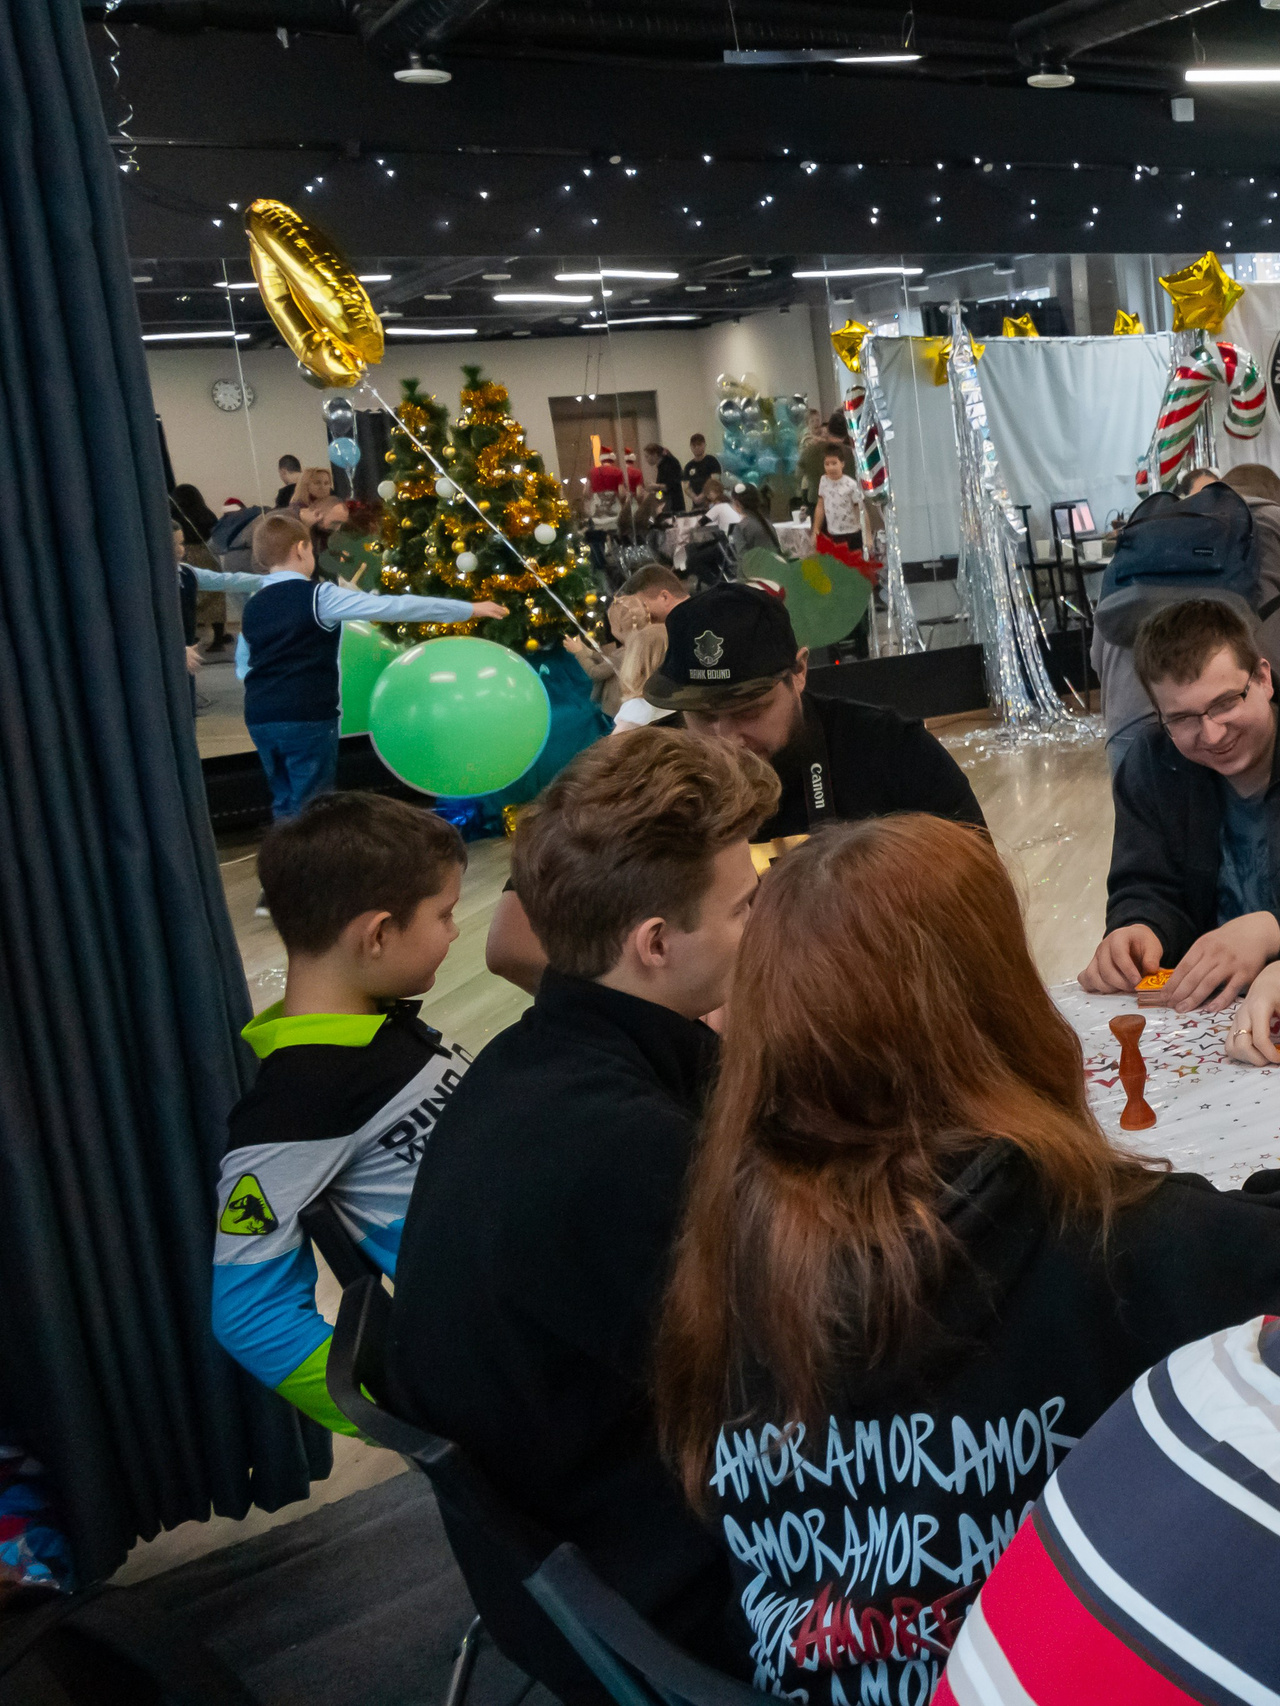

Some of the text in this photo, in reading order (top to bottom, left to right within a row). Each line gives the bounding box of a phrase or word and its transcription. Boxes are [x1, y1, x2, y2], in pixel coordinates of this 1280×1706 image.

[707, 669, 731, 679] BOUND
[810, 762, 826, 809] Canon
[955, 1500, 1034, 1586] AM
